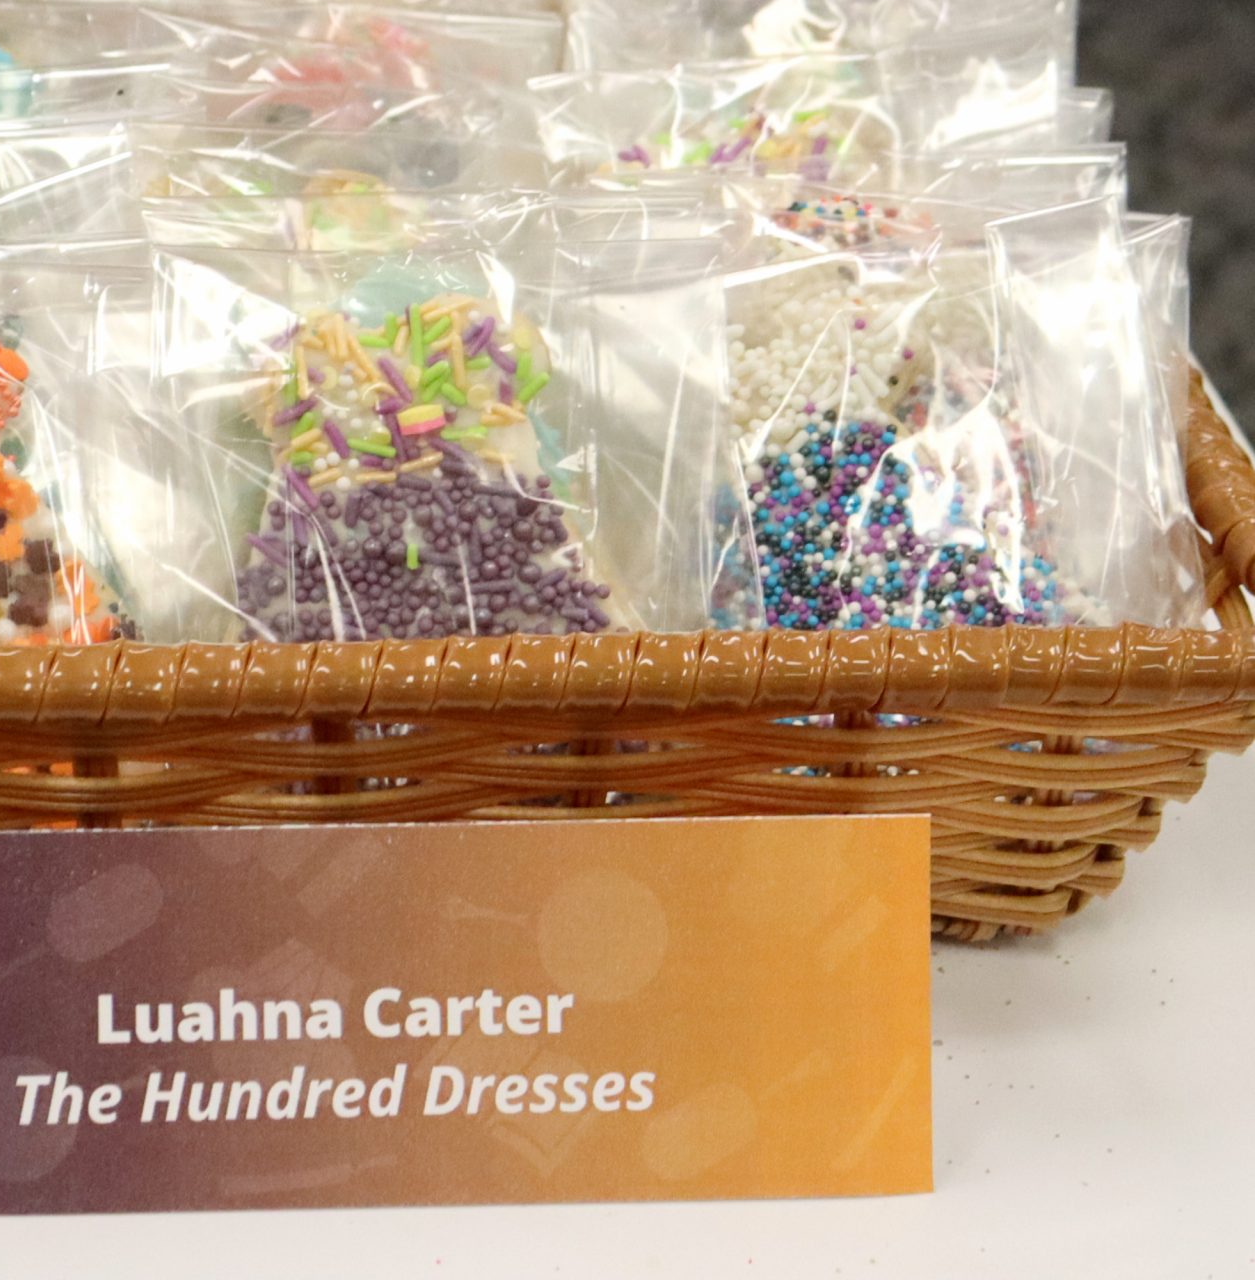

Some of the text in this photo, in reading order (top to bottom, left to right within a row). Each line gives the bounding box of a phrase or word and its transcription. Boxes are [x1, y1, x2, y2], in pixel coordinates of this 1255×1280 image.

[98, 987, 574, 1044] Luahna Carter
[16, 1064, 655, 1125] The Hundred Dresses
